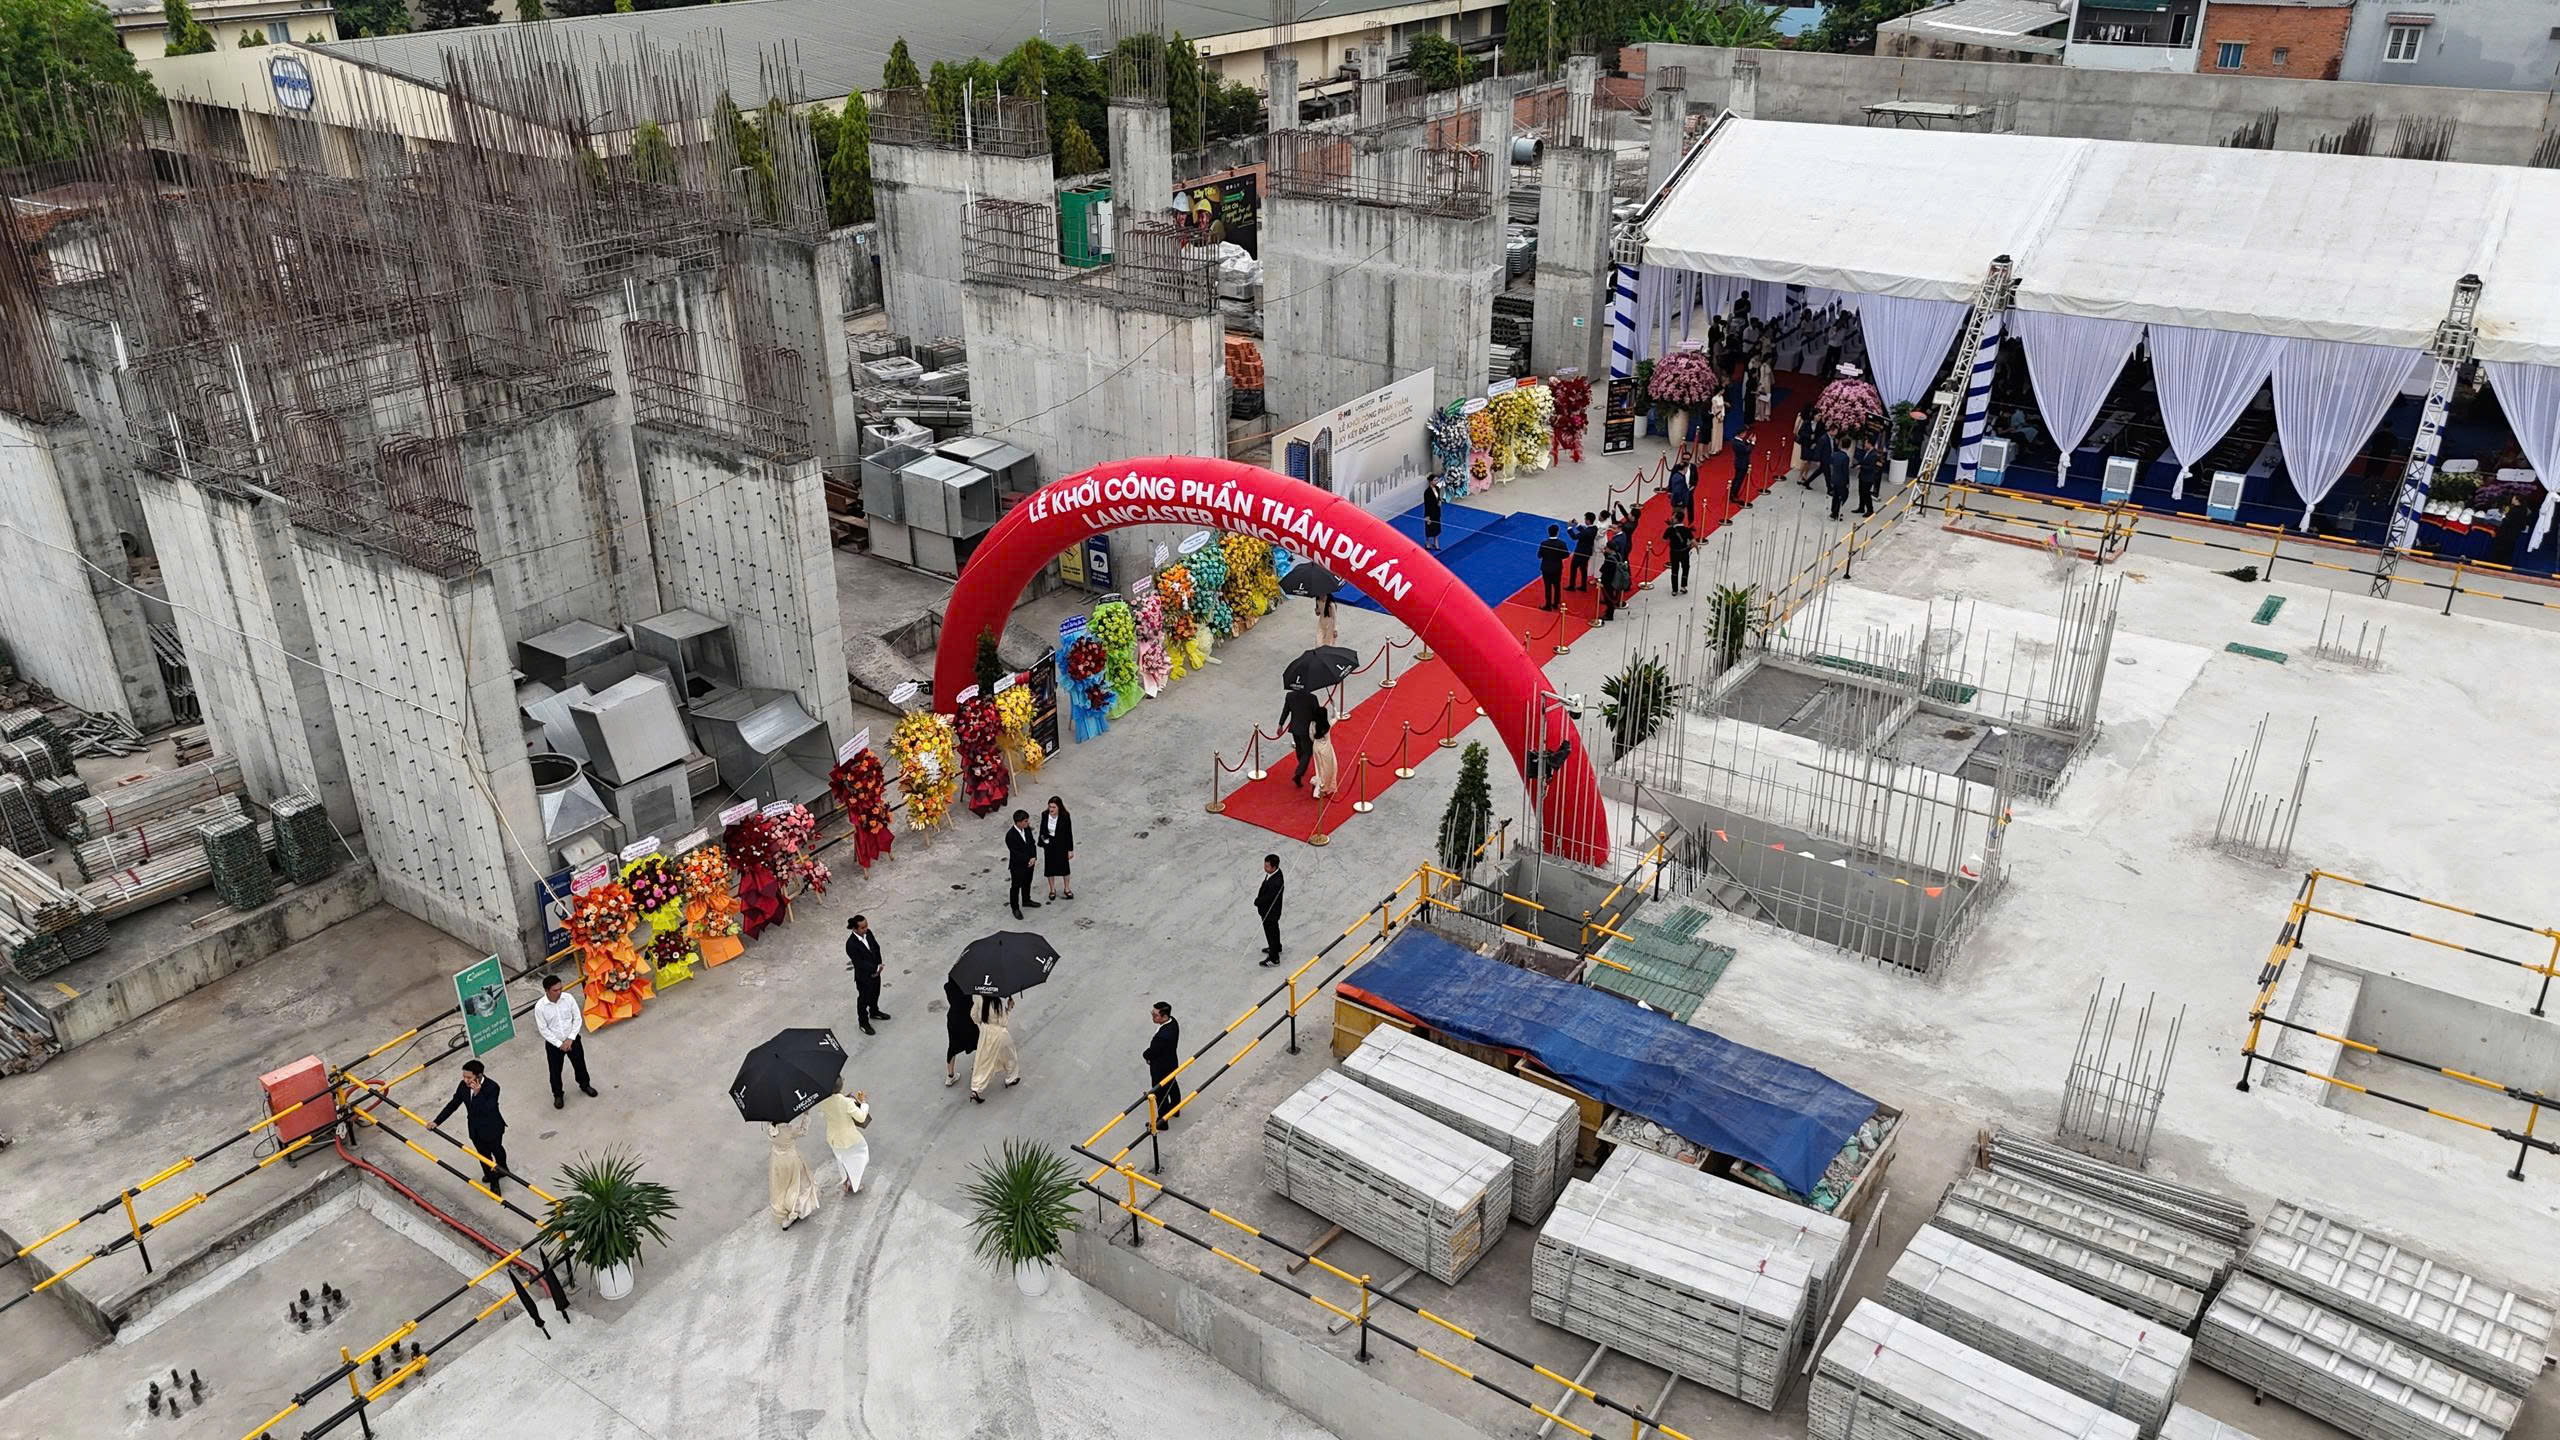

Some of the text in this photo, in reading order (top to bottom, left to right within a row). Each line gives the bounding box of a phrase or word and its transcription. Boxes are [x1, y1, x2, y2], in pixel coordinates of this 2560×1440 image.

[1028, 471, 1414, 602] LỄ KHỞI CÔNG PHẦN THÂN DỰ ÁN
[1081, 504, 1218, 529] LANCASTER
[1221, 513, 1332, 572] LINCOLN
[984, 975, 992, 986] L
[794, 1089, 807, 1101] L
